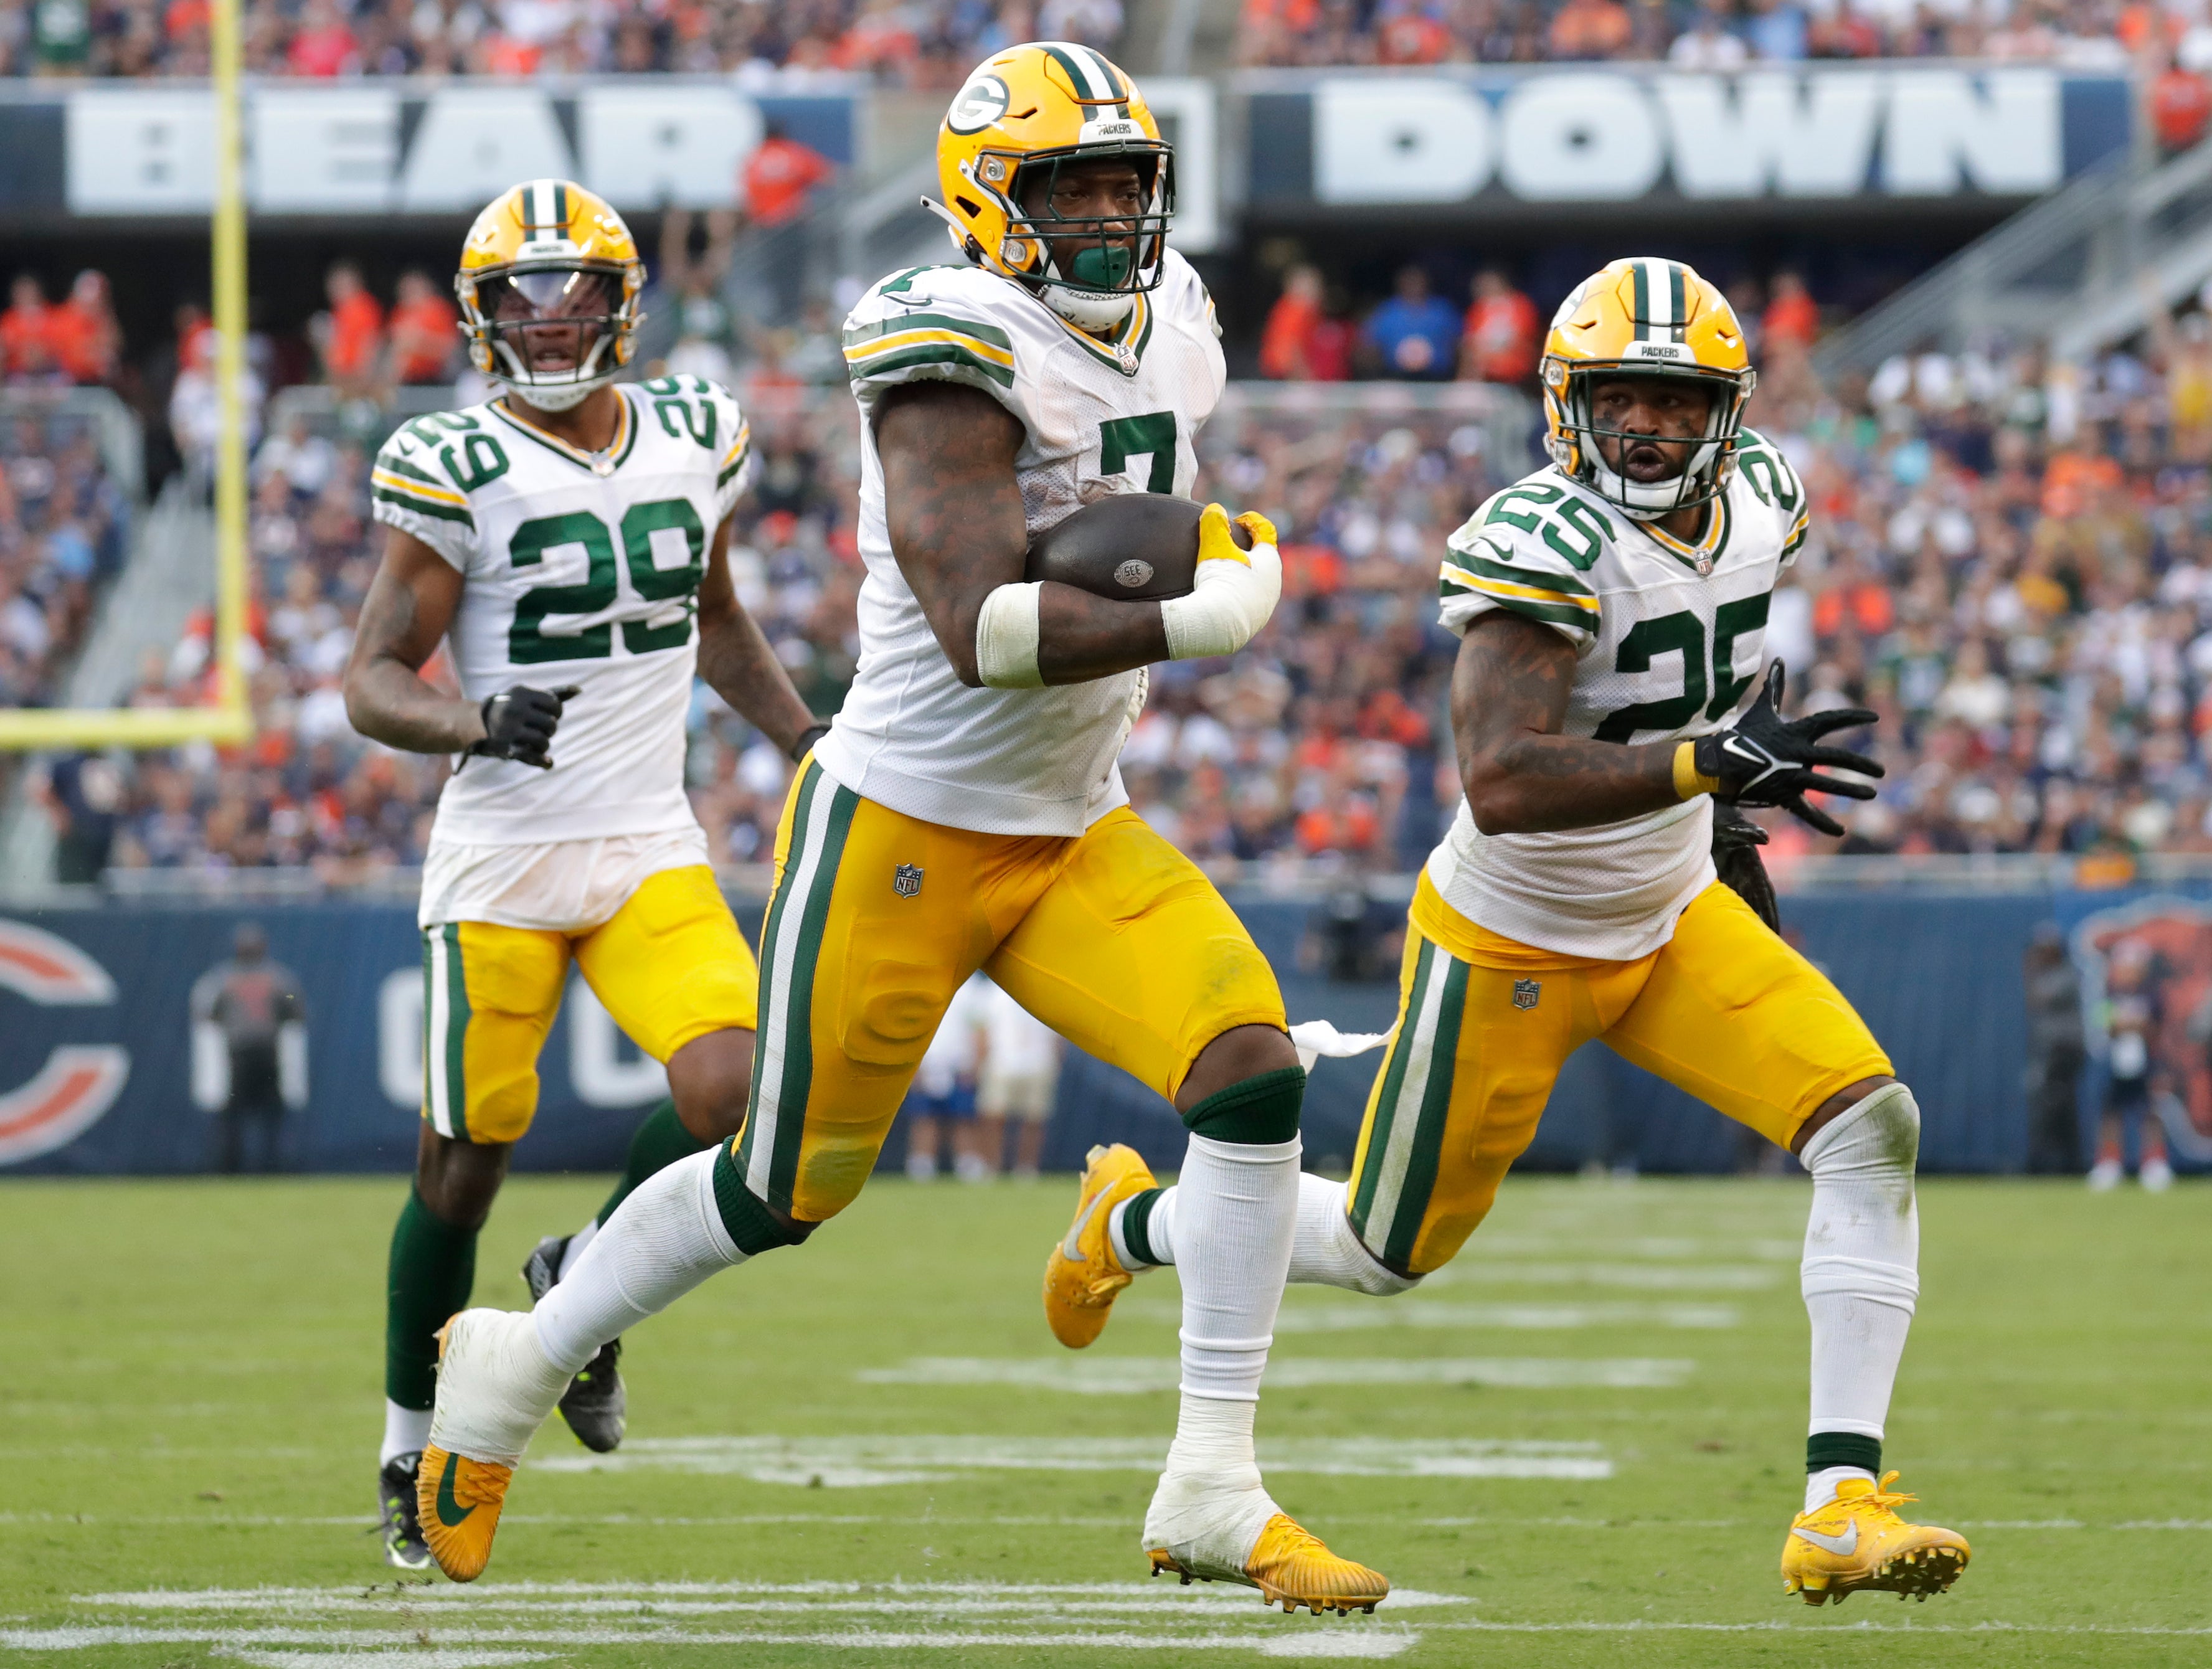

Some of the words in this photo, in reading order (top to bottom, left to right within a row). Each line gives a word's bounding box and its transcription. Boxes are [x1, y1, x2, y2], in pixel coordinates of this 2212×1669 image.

[948, 74, 1010, 136] G
[1313, 70, 2059, 204] DOWN
[65, 85, 765, 216] BEAR
[1642, 346, 1680, 358] PACKERS
[1100, 410, 1176, 494] 7
[1485, 483, 1615, 570] 25
[508, 498, 706, 664] 29
[1592, 591, 1772, 745] 25
[898, 877, 917, 892] NFL
[1517, 992, 1536, 1005] NFL
